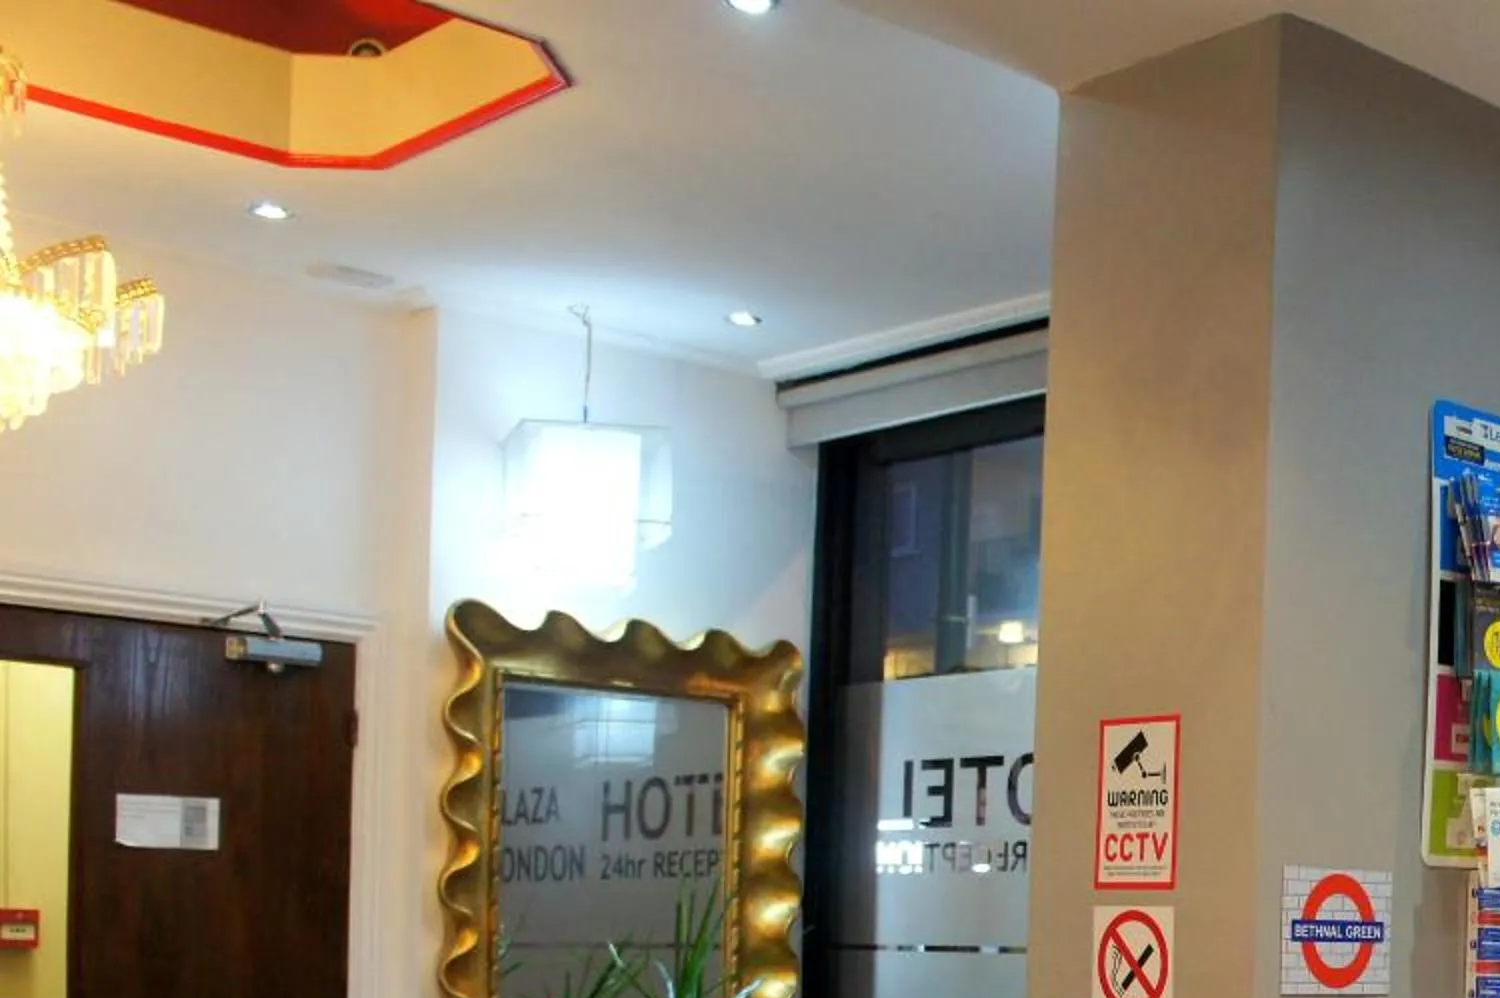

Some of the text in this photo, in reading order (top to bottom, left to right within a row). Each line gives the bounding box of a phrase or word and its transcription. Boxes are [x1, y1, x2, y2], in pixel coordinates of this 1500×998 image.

[1107, 789, 1169, 807] WARNING
[1105, 832, 1169, 862] CCTV
[600, 852, 647, 881] 24hr
[1294, 923, 1381, 939] BETHNAL GREEN
